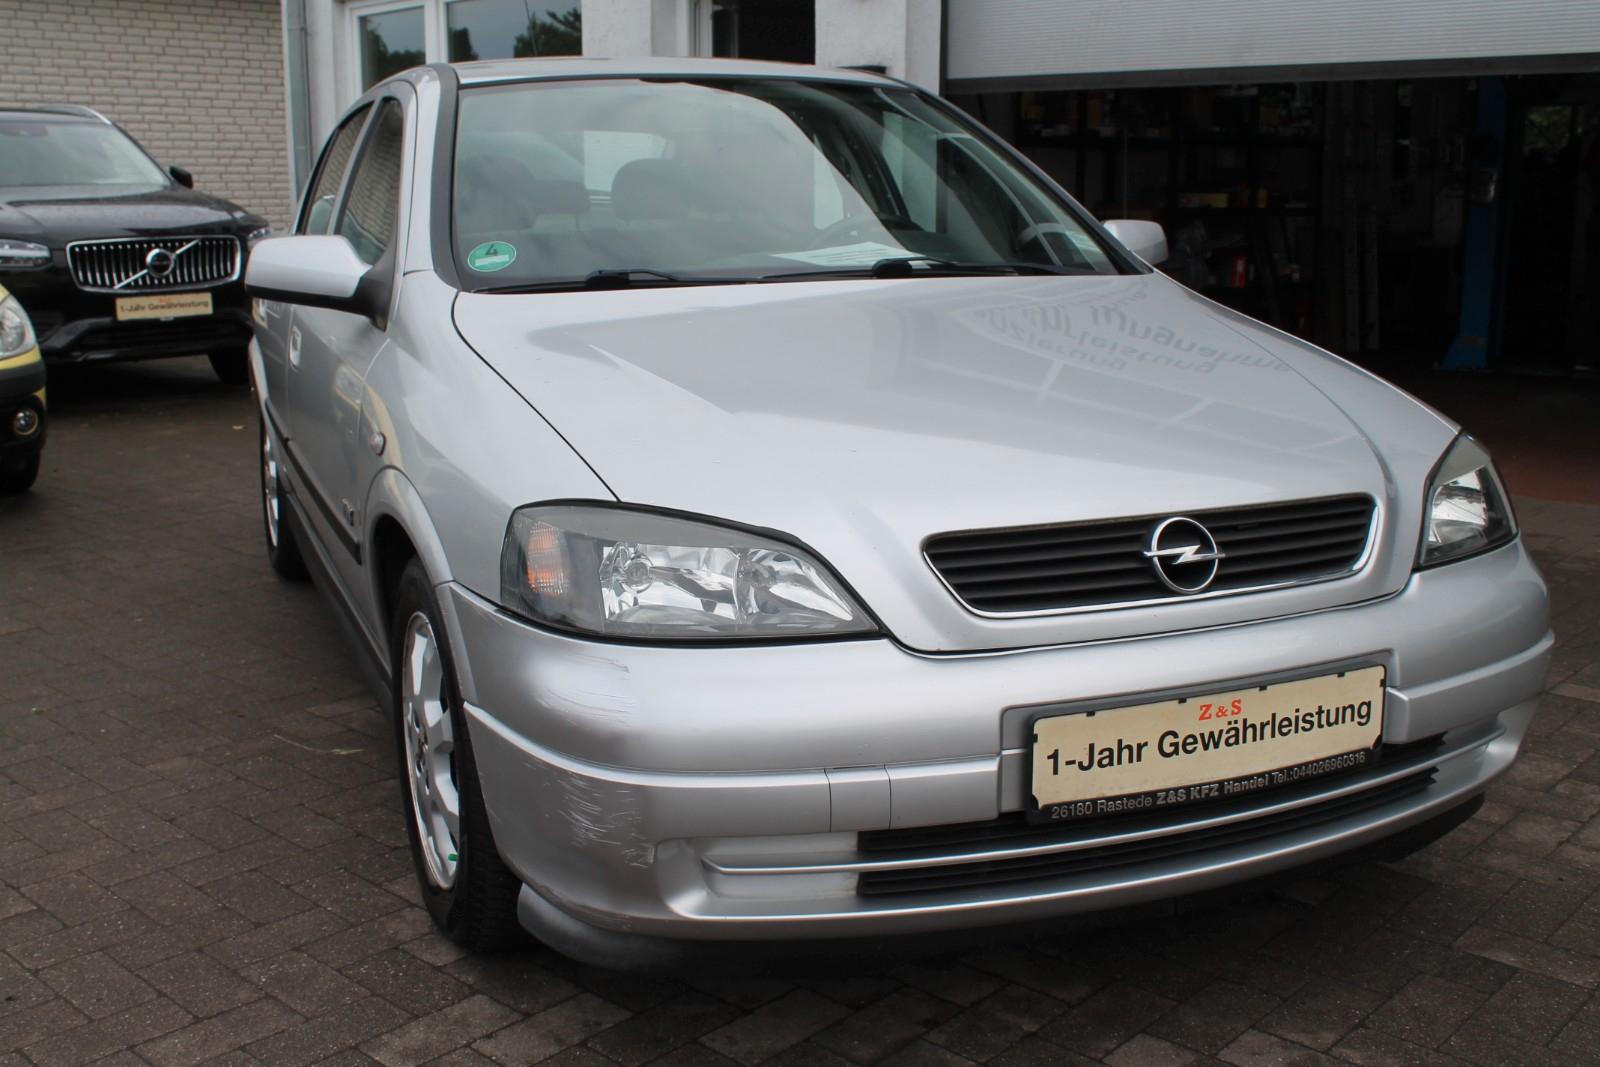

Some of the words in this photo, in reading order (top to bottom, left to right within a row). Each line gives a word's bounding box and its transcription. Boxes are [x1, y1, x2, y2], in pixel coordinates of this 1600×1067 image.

[485, 243, 499, 256] 4
[1046, 737, 1149, 776] 1-Jahr
[1157, 699, 1372, 758] Gewährleistung
[1051, 800, 1094, 820] 26180
[1097, 795, 1153, 813] Rastede
[1156, 789, 1187, 805] Z&S
[1190, 784, 1220, 801] KFZ
[1224, 774, 1269, 795] Handel
